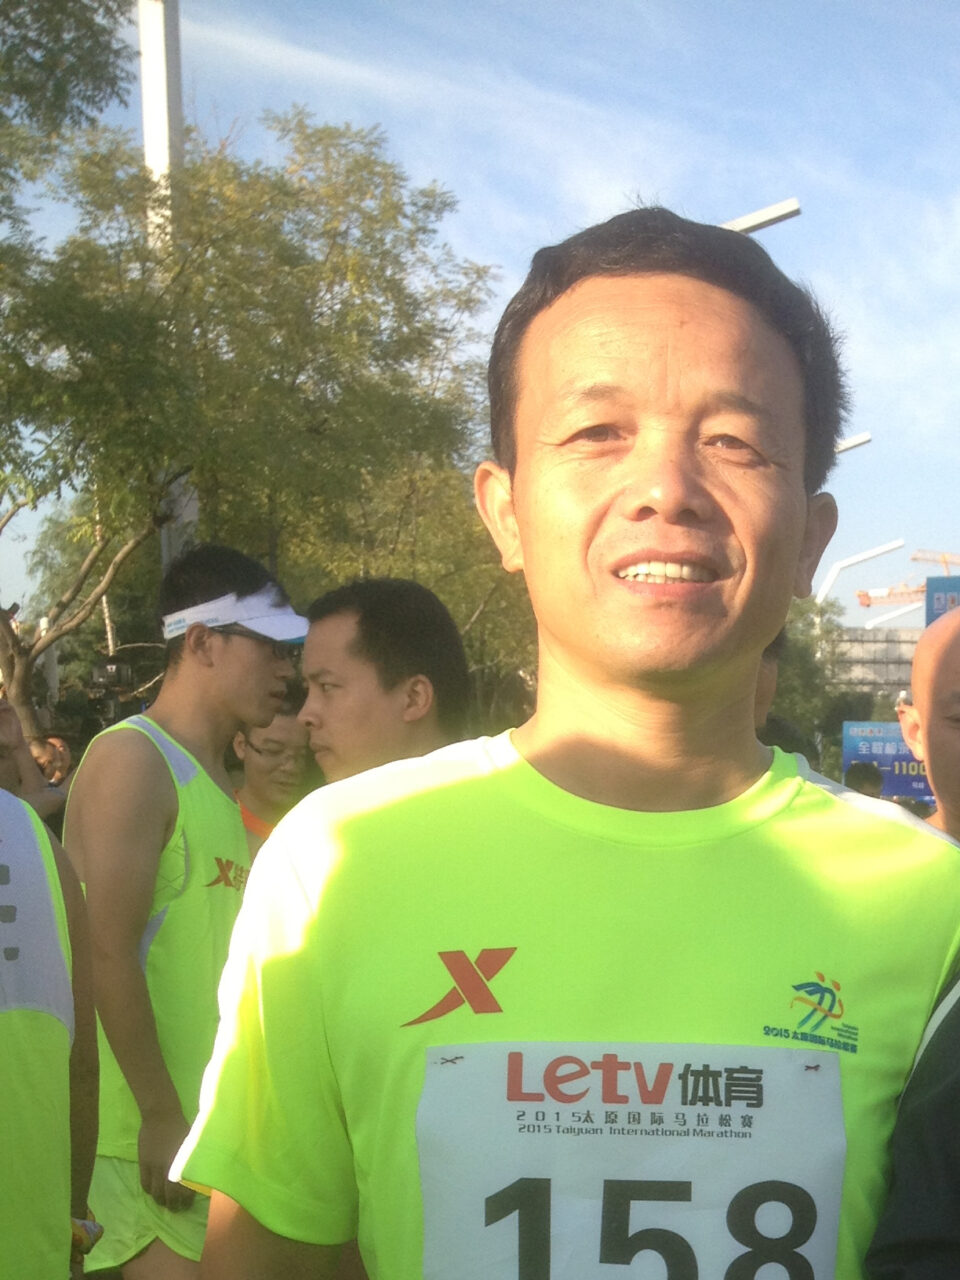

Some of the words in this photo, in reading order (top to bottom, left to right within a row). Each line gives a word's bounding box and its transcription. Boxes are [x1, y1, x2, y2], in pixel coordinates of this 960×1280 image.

[506, 1051, 675, 1105] Letv
[677, 1063, 764, 1108] 体育
[518, 1123, 552, 1134] 2015
[555, 1124, 603, 1137] Taiyuan
[609, 1126, 690, 1138] International
[692, 1128, 752, 1139] Marathon
